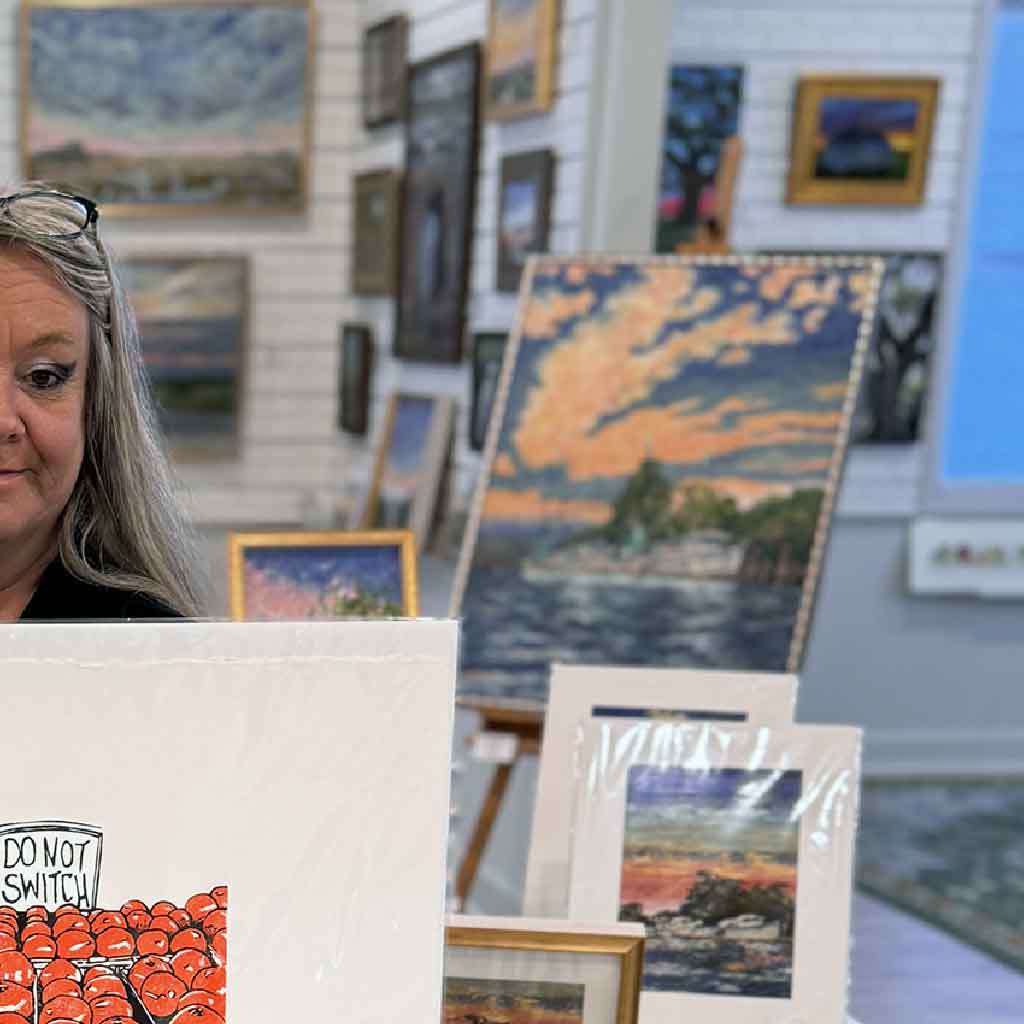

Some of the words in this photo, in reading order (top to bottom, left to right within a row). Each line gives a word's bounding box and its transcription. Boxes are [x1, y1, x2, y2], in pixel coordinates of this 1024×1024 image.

[3, 836, 37, 869] DO
[43, 836, 92, 873] NOT
[1, 870, 91, 908] SWITCH
